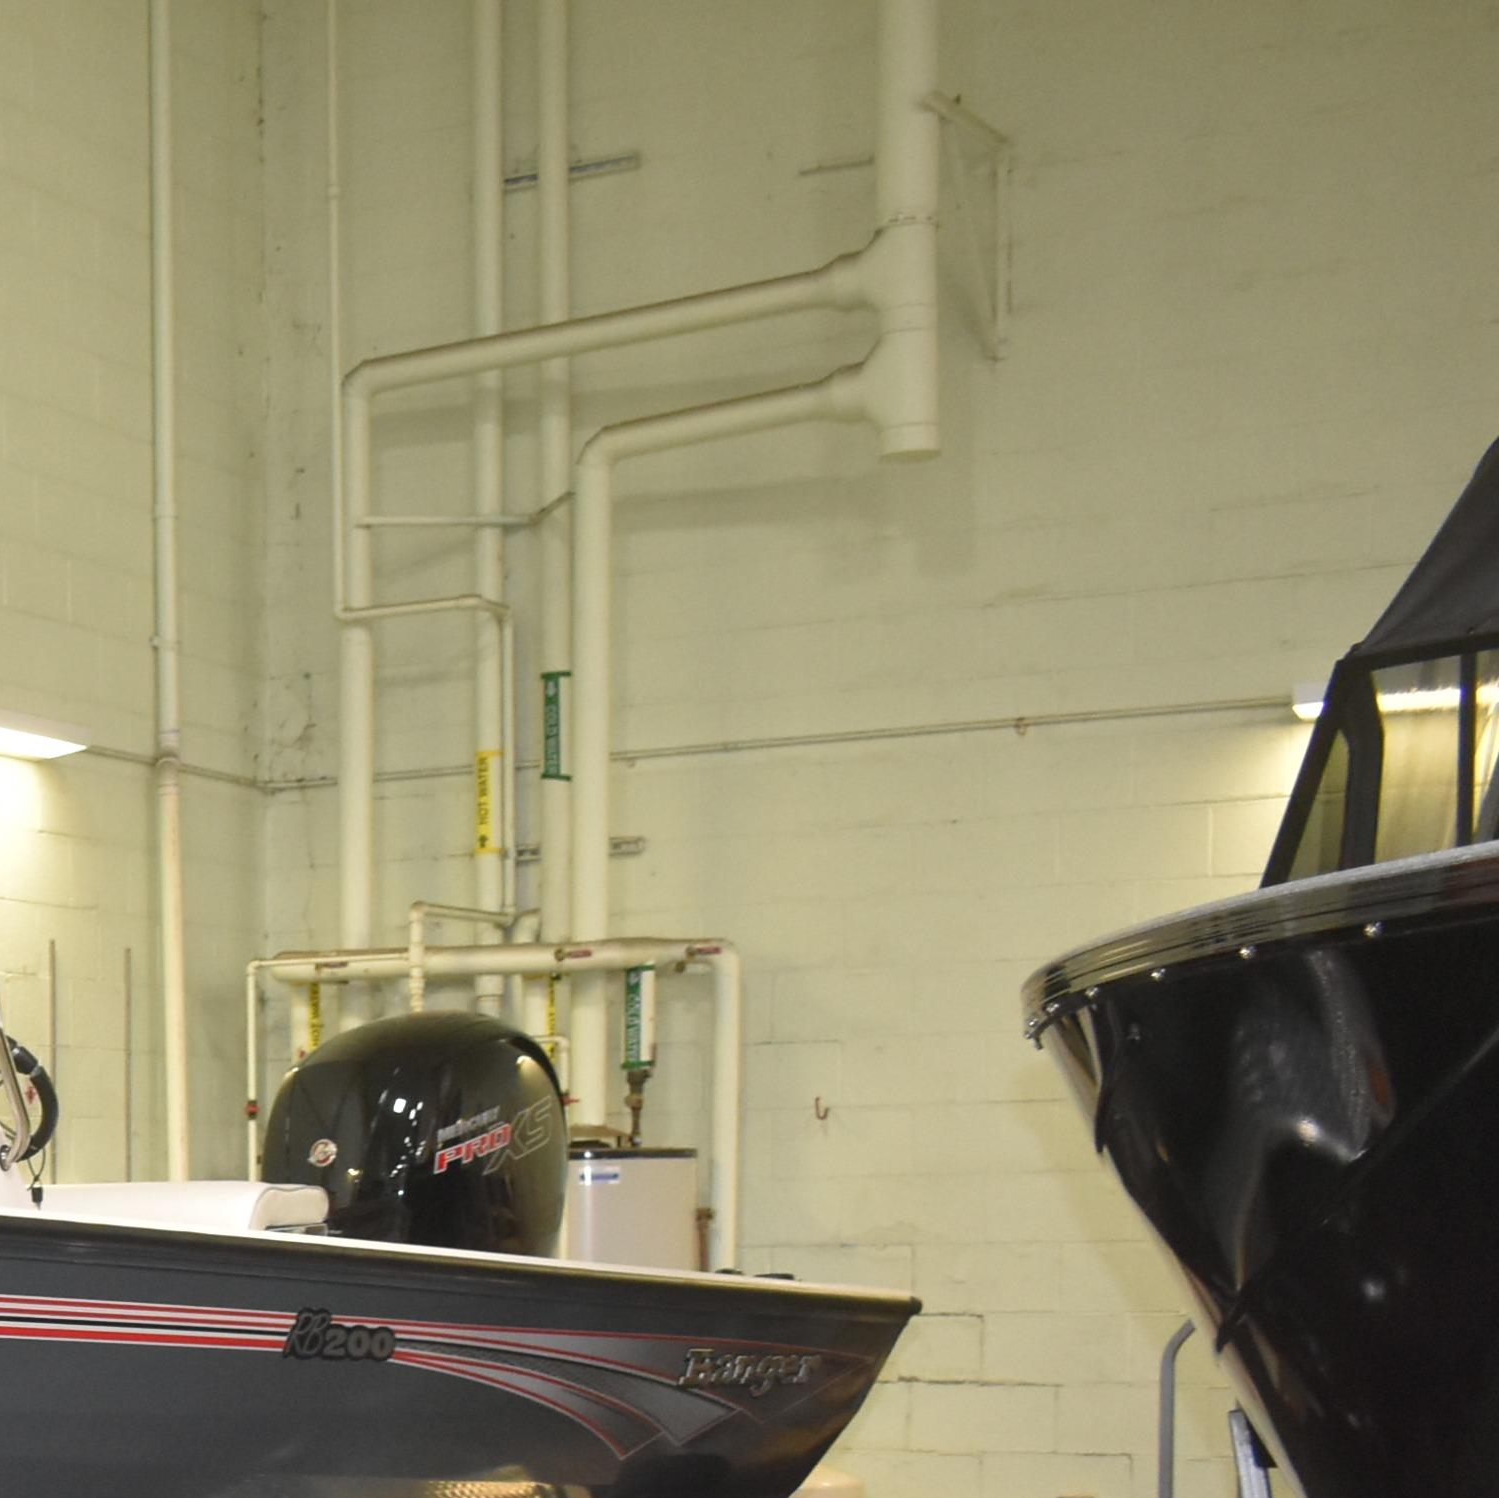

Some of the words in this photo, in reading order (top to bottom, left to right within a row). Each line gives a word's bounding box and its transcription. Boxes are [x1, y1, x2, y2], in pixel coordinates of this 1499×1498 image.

[477, 757, 489, 797] WATER
[477, 802, 489, 825] HOT
[433, 1122, 513, 1175] PRO
[678, 1347, 821, 1398] Ranger
